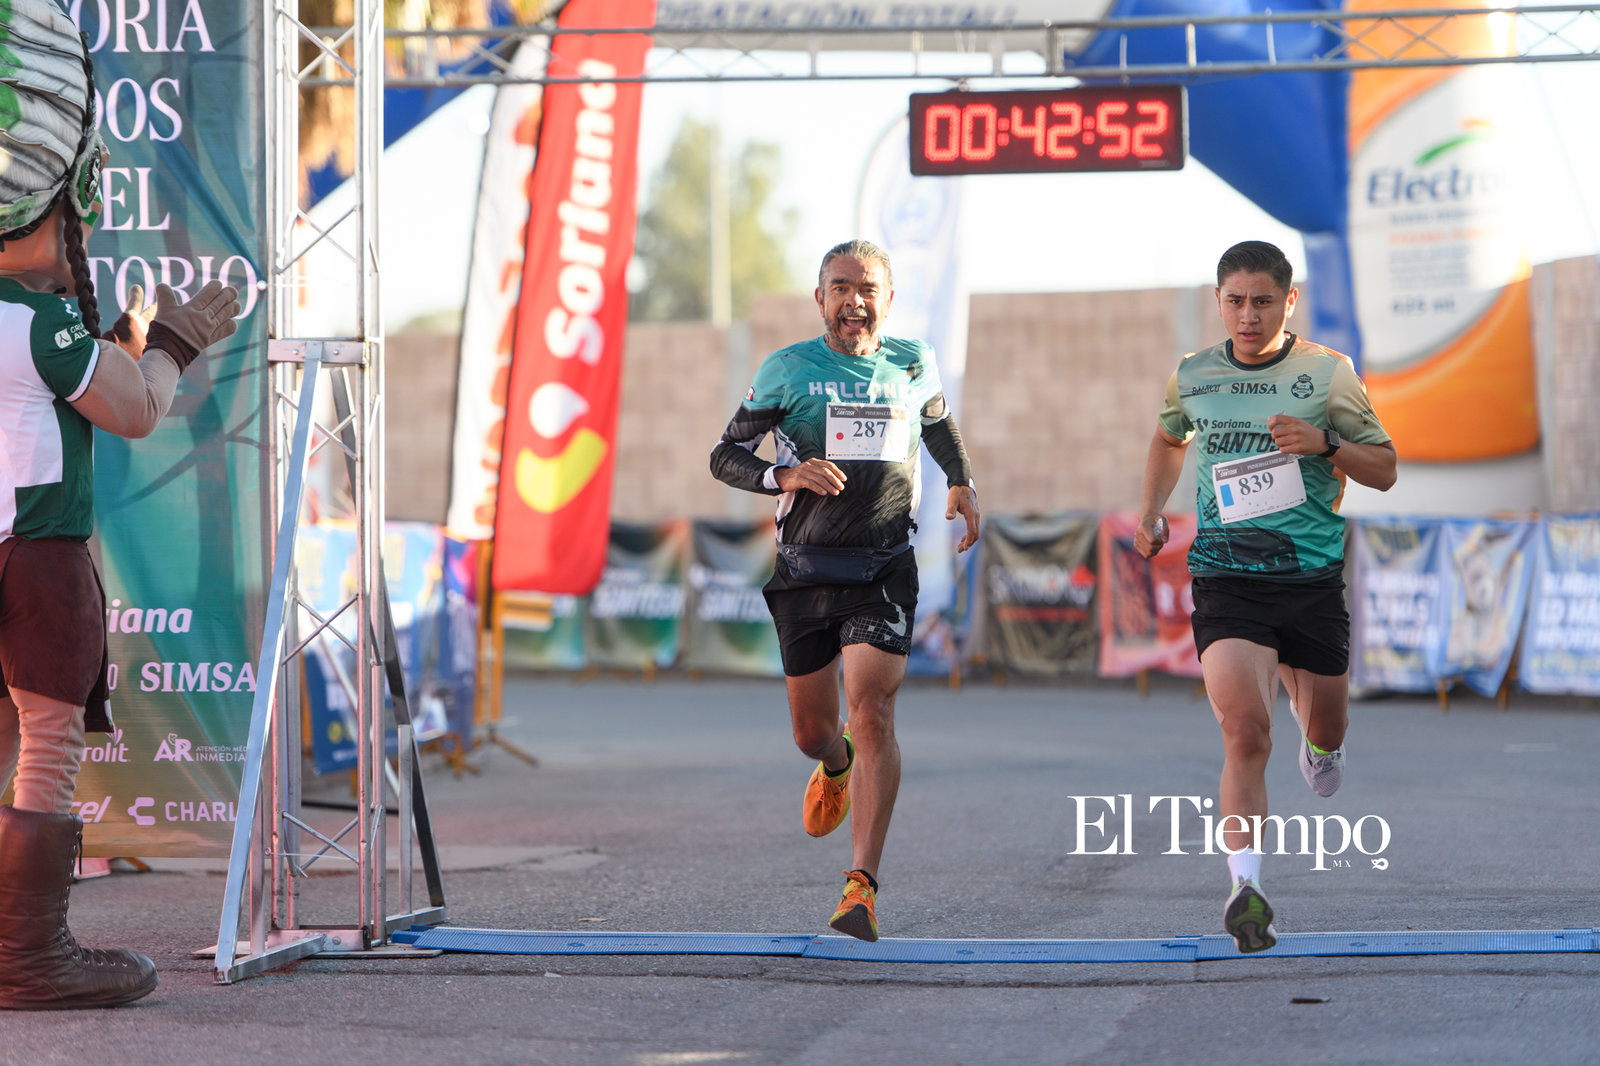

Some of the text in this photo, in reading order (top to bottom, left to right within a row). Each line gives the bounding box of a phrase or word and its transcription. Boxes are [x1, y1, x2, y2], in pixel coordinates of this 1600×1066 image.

[65, 0, 217, 53] ORIA
[95, 77, 183, 142] OS
[924, 100, 1169, 162] 00:42:52
[1230, 382, 1278, 395] SIMSA
[852, 420, 888, 439] 287
[1211, 418, 1252, 430] Soriana
[1238, 471, 1275, 497] 839
[105, 598, 193, 634] iana
[139, 661, 258, 693] SIMSA
